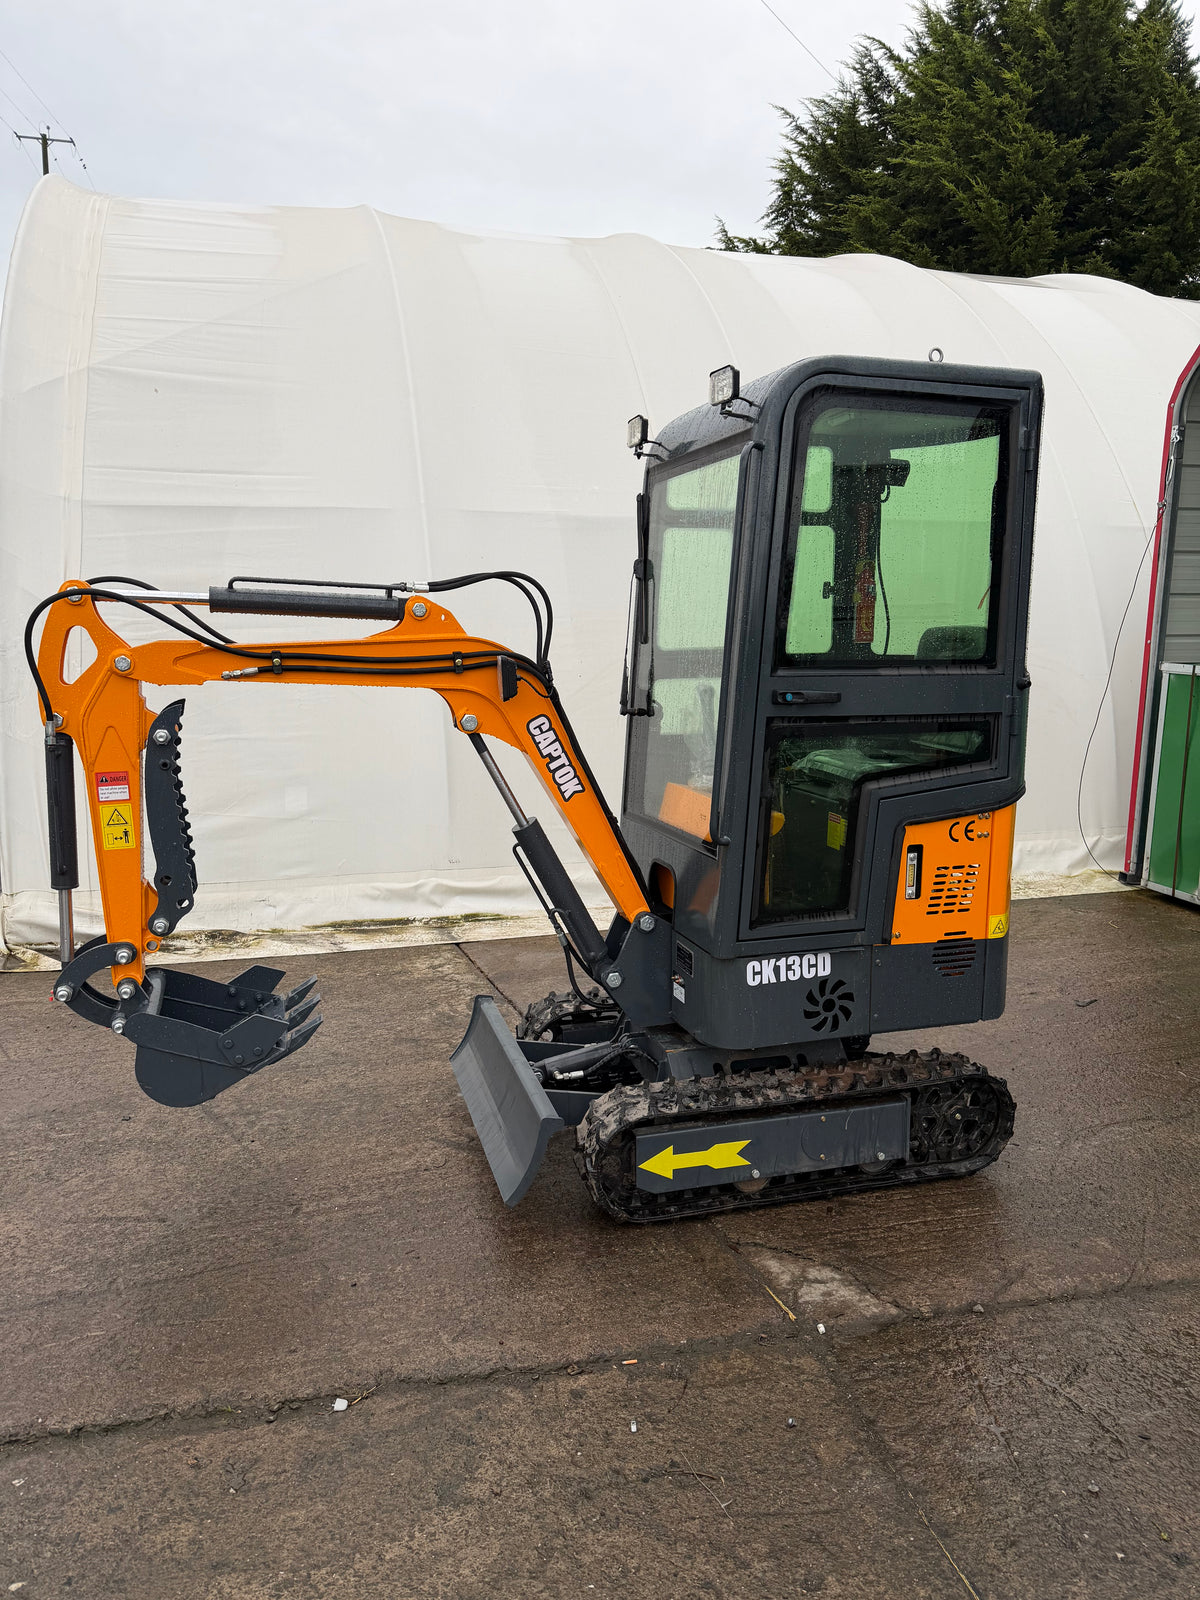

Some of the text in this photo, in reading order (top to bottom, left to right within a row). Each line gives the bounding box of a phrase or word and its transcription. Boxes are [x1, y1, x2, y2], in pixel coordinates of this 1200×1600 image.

[528, 716, 584, 800] CAPTOK
[949, 820, 975, 842] CE
[746, 952, 832, 987] CK13CD
